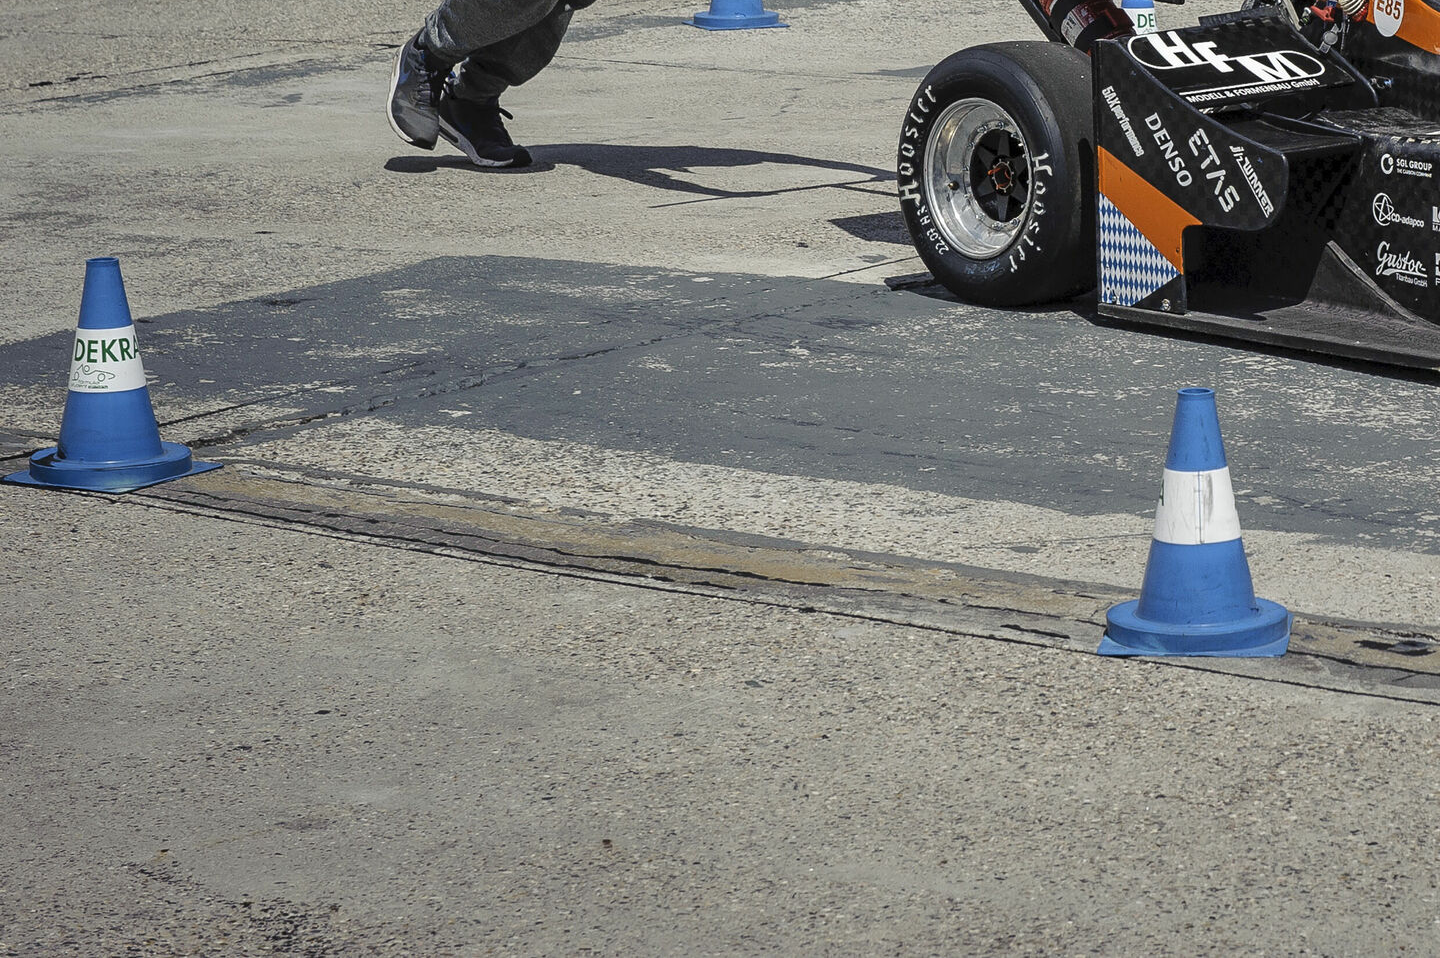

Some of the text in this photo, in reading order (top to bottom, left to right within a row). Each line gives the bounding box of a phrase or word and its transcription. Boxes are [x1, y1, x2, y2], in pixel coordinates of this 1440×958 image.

[1147, 31, 1309, 83] HFM
[1186, 78, 1321, 103] MODELL & FORMENBAU GmbH
[901, 85, 937, 208] Hoosier
[1145, 112, 1193, 187] DENSO
[1188, 128, 1241, 213] ETAS
[1396, 158, 1433, 171] SGL GROUP
[1010, 152, 1053, 273] Hoosier
[1391, 213, 1425, 228] CD-adapco
[1414, 277, 1428, 288] GmbH
